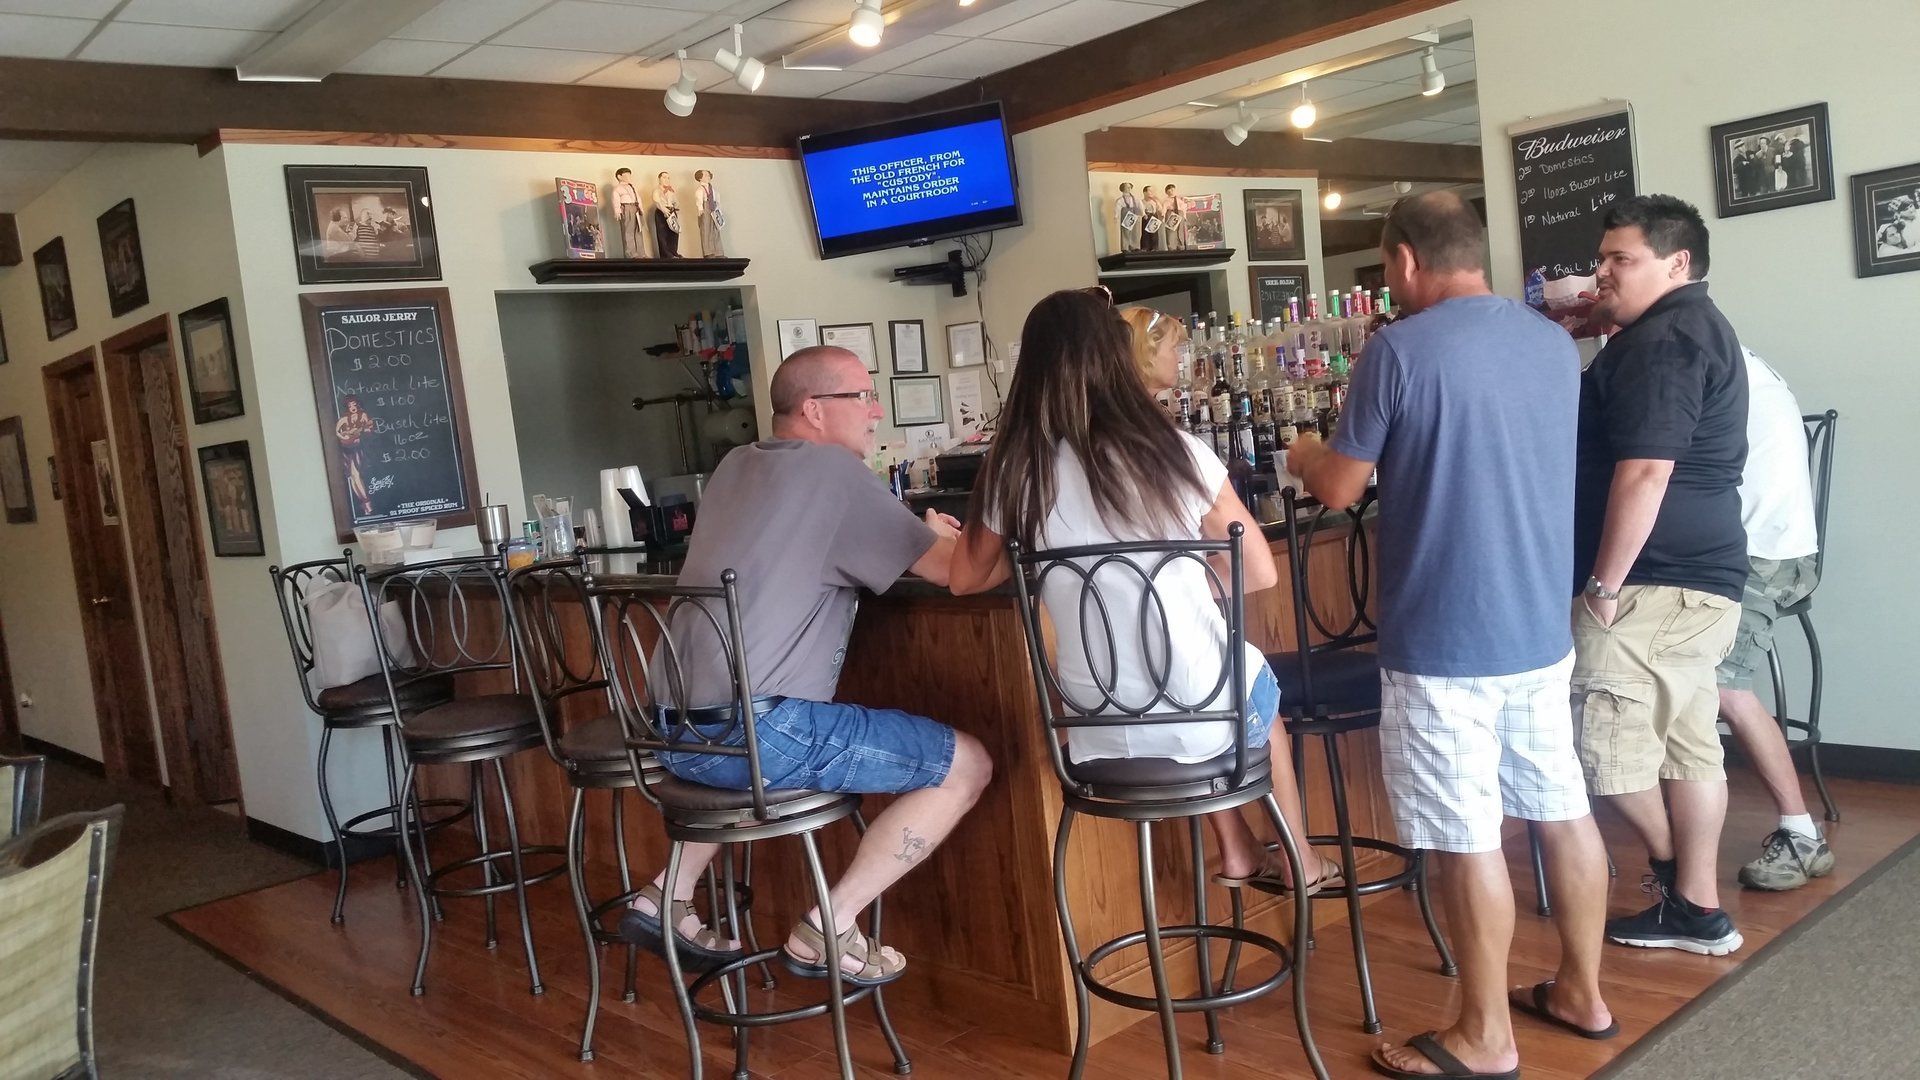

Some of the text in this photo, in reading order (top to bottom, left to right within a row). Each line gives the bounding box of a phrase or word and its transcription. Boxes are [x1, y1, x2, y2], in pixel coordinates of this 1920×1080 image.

[1517, 127, 1627, 161] Budweiser
[850, 158, 965, 185] THE OLD FRENCH FOR
[852, 150, 961, 176] THIS OFFICER, FROM
[1538, 154, 1595, 175] Domestics
[862, 176, 960, 200] MAINTAINS ORDER
[1569, 175, 1600, 192] Busch
[1604, 169, 1628, 182] Lite
[866, 185, 959, 208] IN A COURTROOM
[1541, 207, 1581, 226] Natural
[1591, 191, 1617, 212] Lite
[1552, 262, 1583, 277] Rail
[341, 312, 418, 324] SAILOR JERRY
[373, 413, 420, 434] Busch
[398, 506, 420, 515] PROOF
[420, 504, 444, 512] SPICED
[415, 498, 445, 507] ORIGINAL
